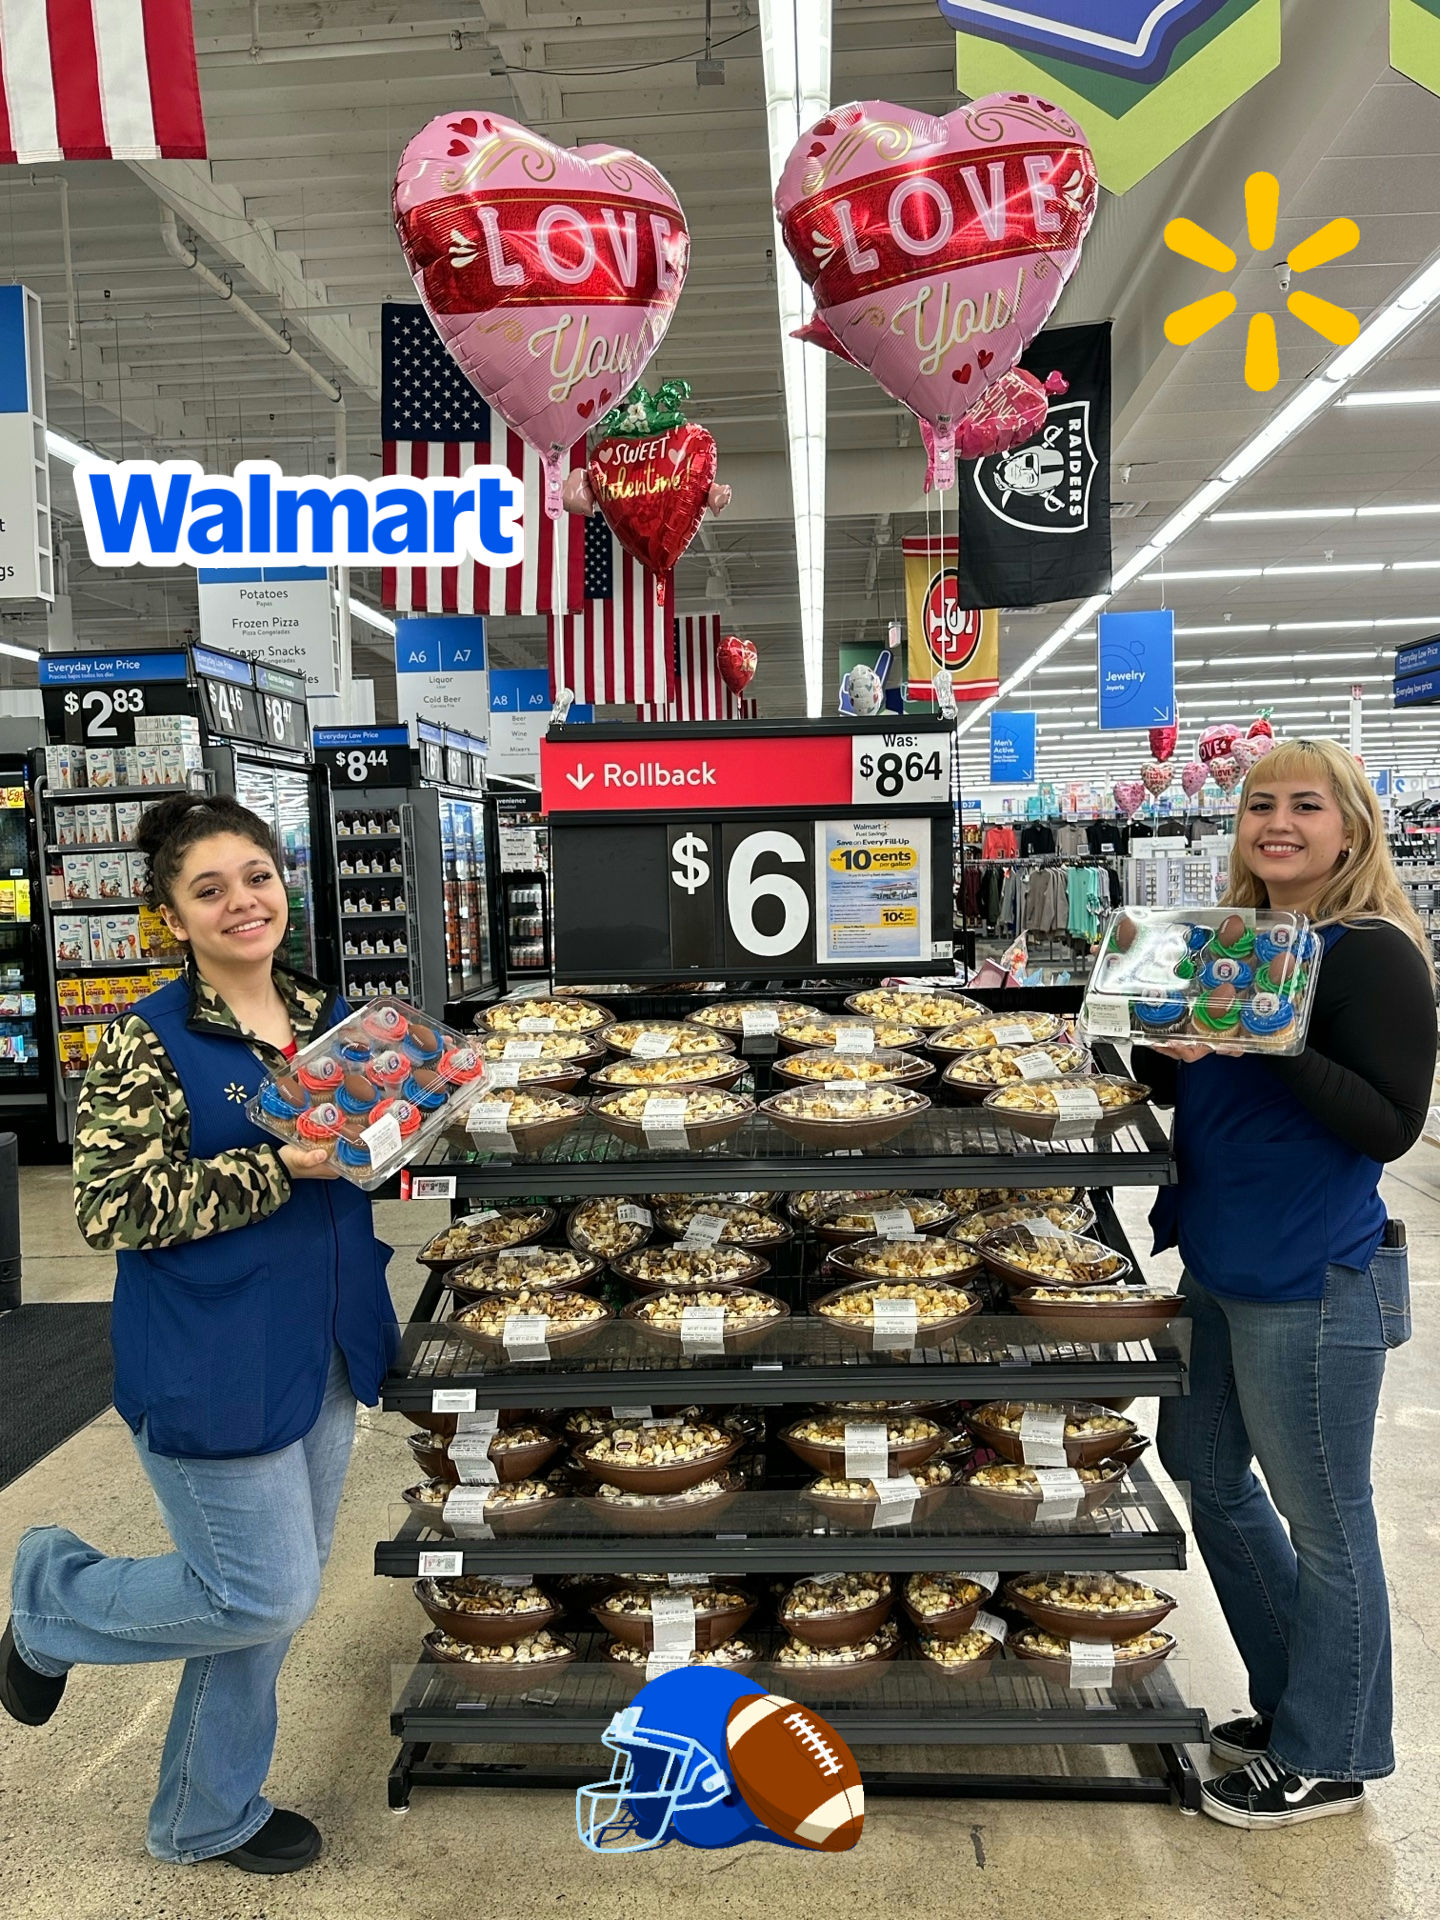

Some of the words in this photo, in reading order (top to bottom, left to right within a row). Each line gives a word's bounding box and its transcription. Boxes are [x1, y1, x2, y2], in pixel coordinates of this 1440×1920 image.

[832, 155, 1061, 274] LOVE
[476, 205, 674, 290] LOVE
[891, 267, 1024, 375] You!
[613, 436, 670, 465] SWEET
[1068, 418, 1082, 517] RAIDERS
[240, 589, 289, 599] Potatoes
[232, 618, 269, 628] Frozen
[272, 617, 300, 628] Pizza
[268, 645, 307, 656] Snacks
[408, 650, 427, 663] A6
[454, 649, 471, 662] A7
[48, 661, 92, 673] Everyday
[94, 660, 113, 671] Low
[116, 659, 141, 670] Price
[429, 676, 454, 685] Liquor
[1105, 670, 1146, 682] Jewelry
[423, 695, 443, 703] Cold
[493, 695, 508, 706] A8
[529, 694, 544, 704] A9
[319, 732, 348, 741] Everyday
[363, 731, 379, 739] Price
[882, 733, 918, 748] Was:
[1200, 740, 1222, 759] OVE
[604, 761, 717, 787] Rollback
[853, 823, 881, 831] Walmart
[862, 839, 884, 847] Every
[884, 838, 910, 846] Fill-Up
[840, 849, 872, 870] 10
[872, 851, 912, 861] cents
[883, 911, 905, 923] 10¢
